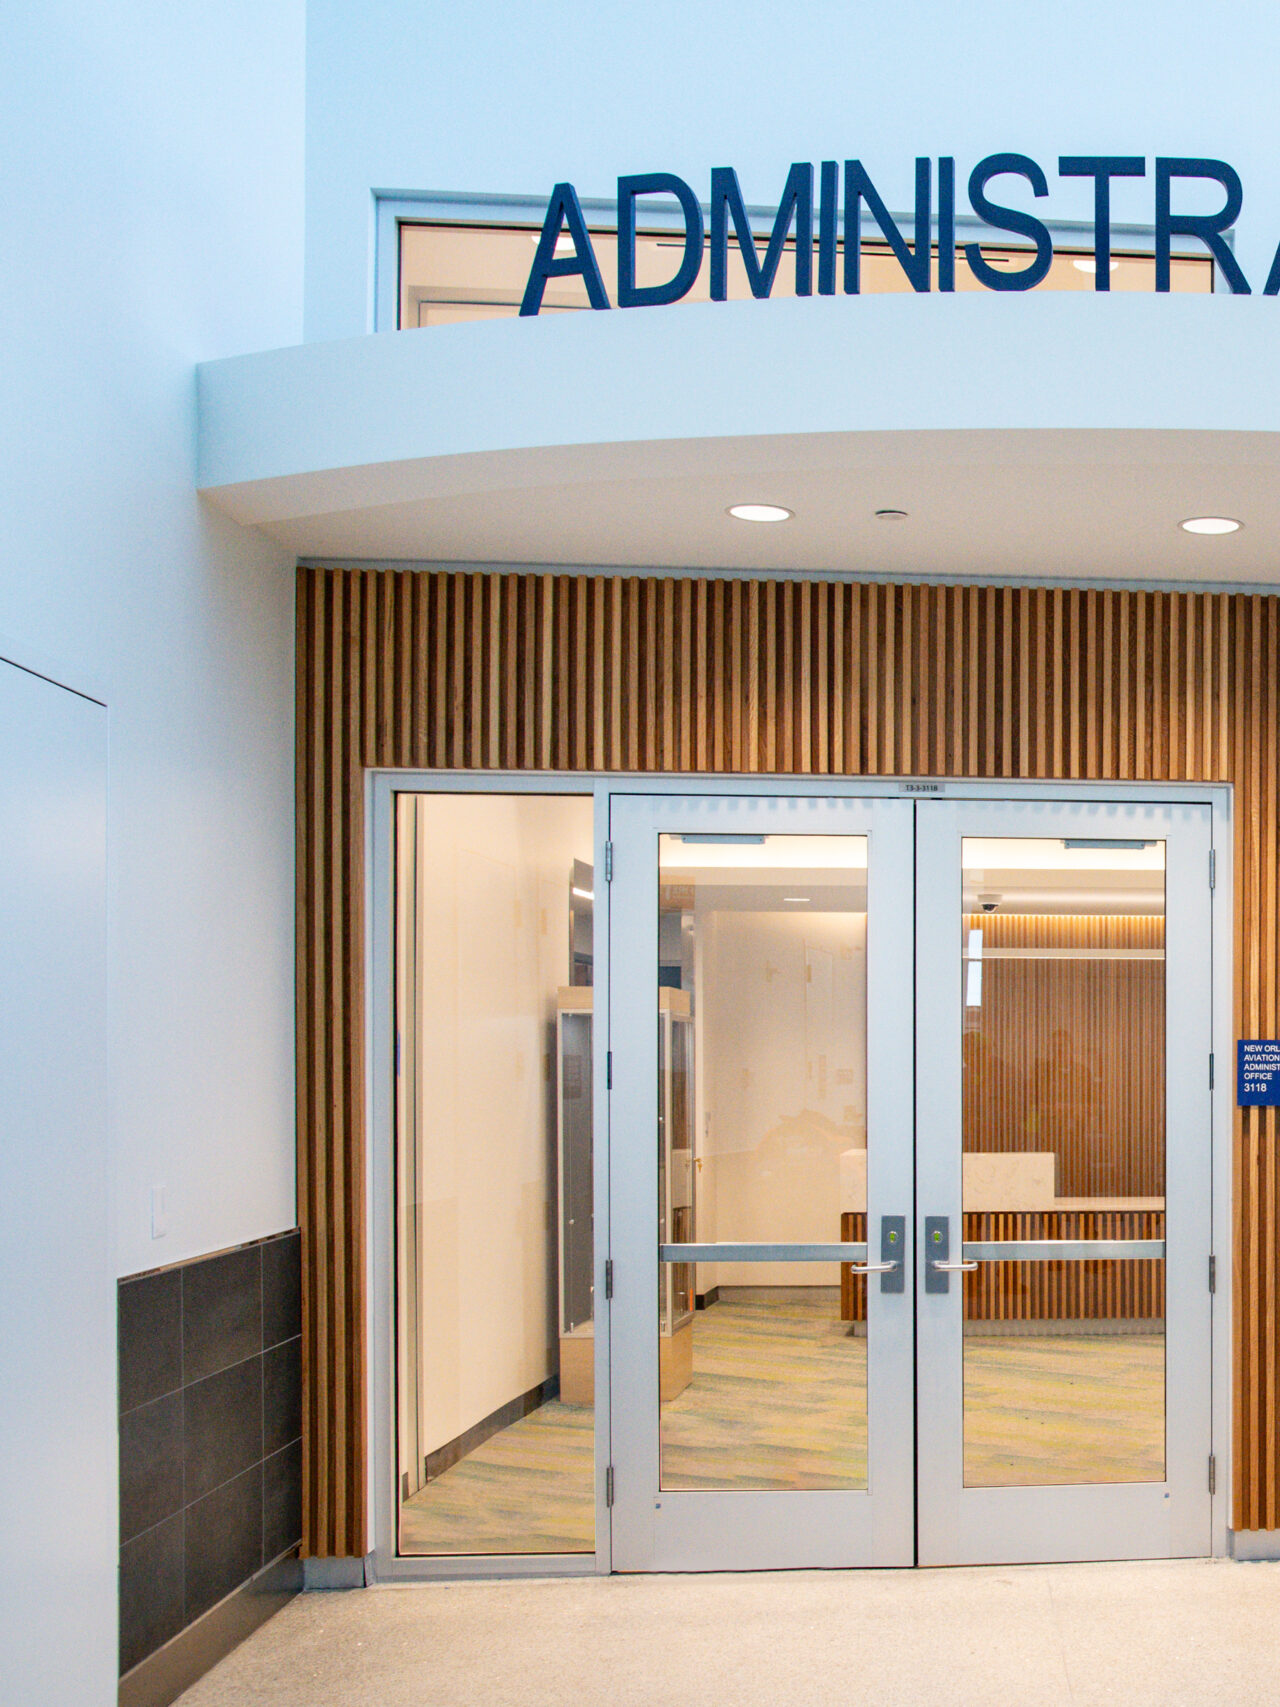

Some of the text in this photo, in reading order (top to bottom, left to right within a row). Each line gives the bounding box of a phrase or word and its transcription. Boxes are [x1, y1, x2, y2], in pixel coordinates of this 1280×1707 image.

[1244, 1045, 1263, 1053] NEW
[1244, 1054, 1280, 1062] AVIATION
[1244, 1083, 1267, 1092] 3118
